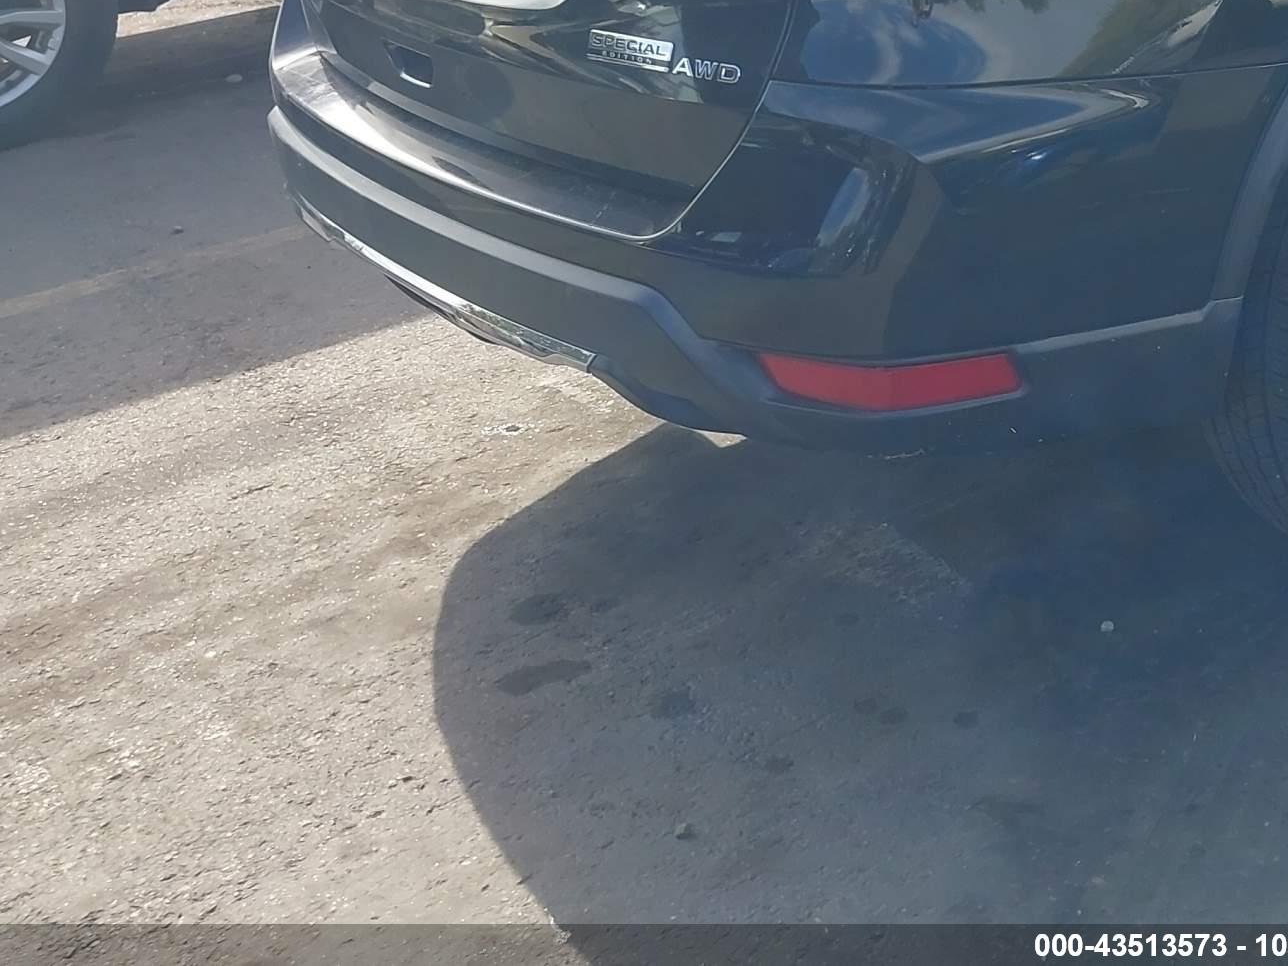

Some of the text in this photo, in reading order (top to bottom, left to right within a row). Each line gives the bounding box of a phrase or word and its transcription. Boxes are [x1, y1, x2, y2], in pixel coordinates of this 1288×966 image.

[591, 33, 667, 57] SPECIAL
[601, 50, 653, 65] EDITION
[672, 57, 741, 84] AWD
